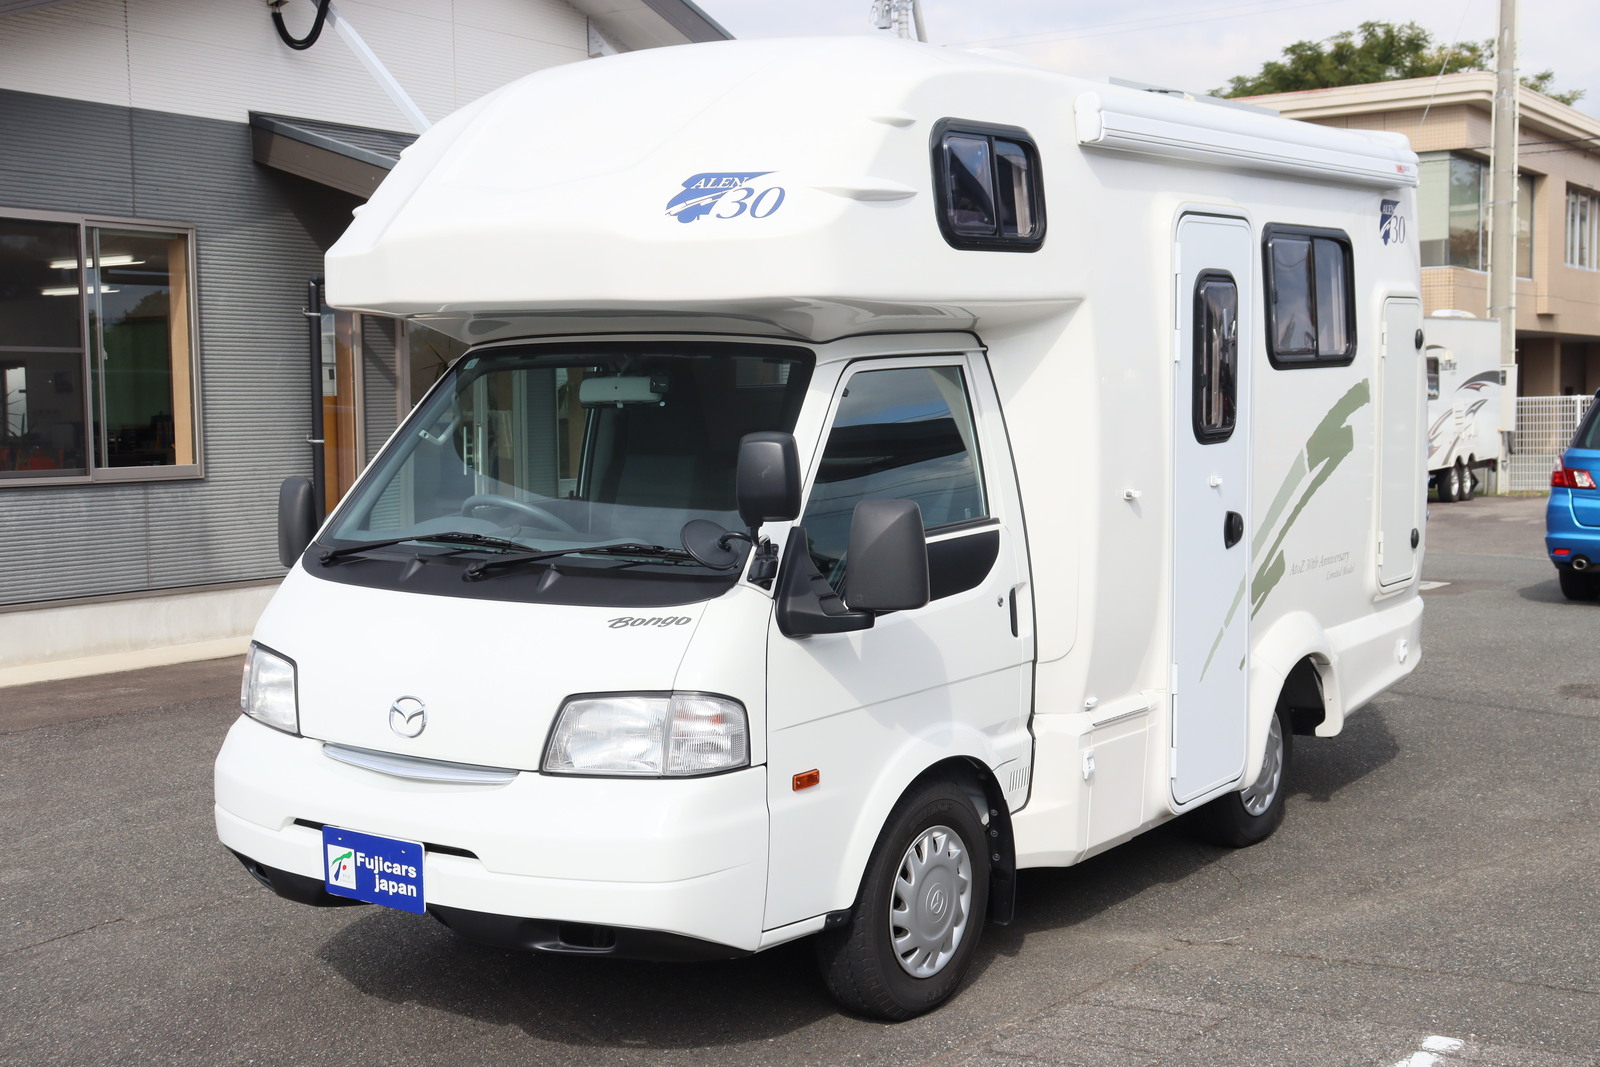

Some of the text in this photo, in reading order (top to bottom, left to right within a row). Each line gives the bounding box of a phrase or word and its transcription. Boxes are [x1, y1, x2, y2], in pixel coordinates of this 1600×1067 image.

[690, 176, 750, 189] ALEN
[715, 186, 786, 219] 30
[1391, 214, 1406, 244] 30
[607, 616, 692, 629] Bongo
[356, 851, 417, 879] Fujicars
[374, 873, 417, 898] japan
